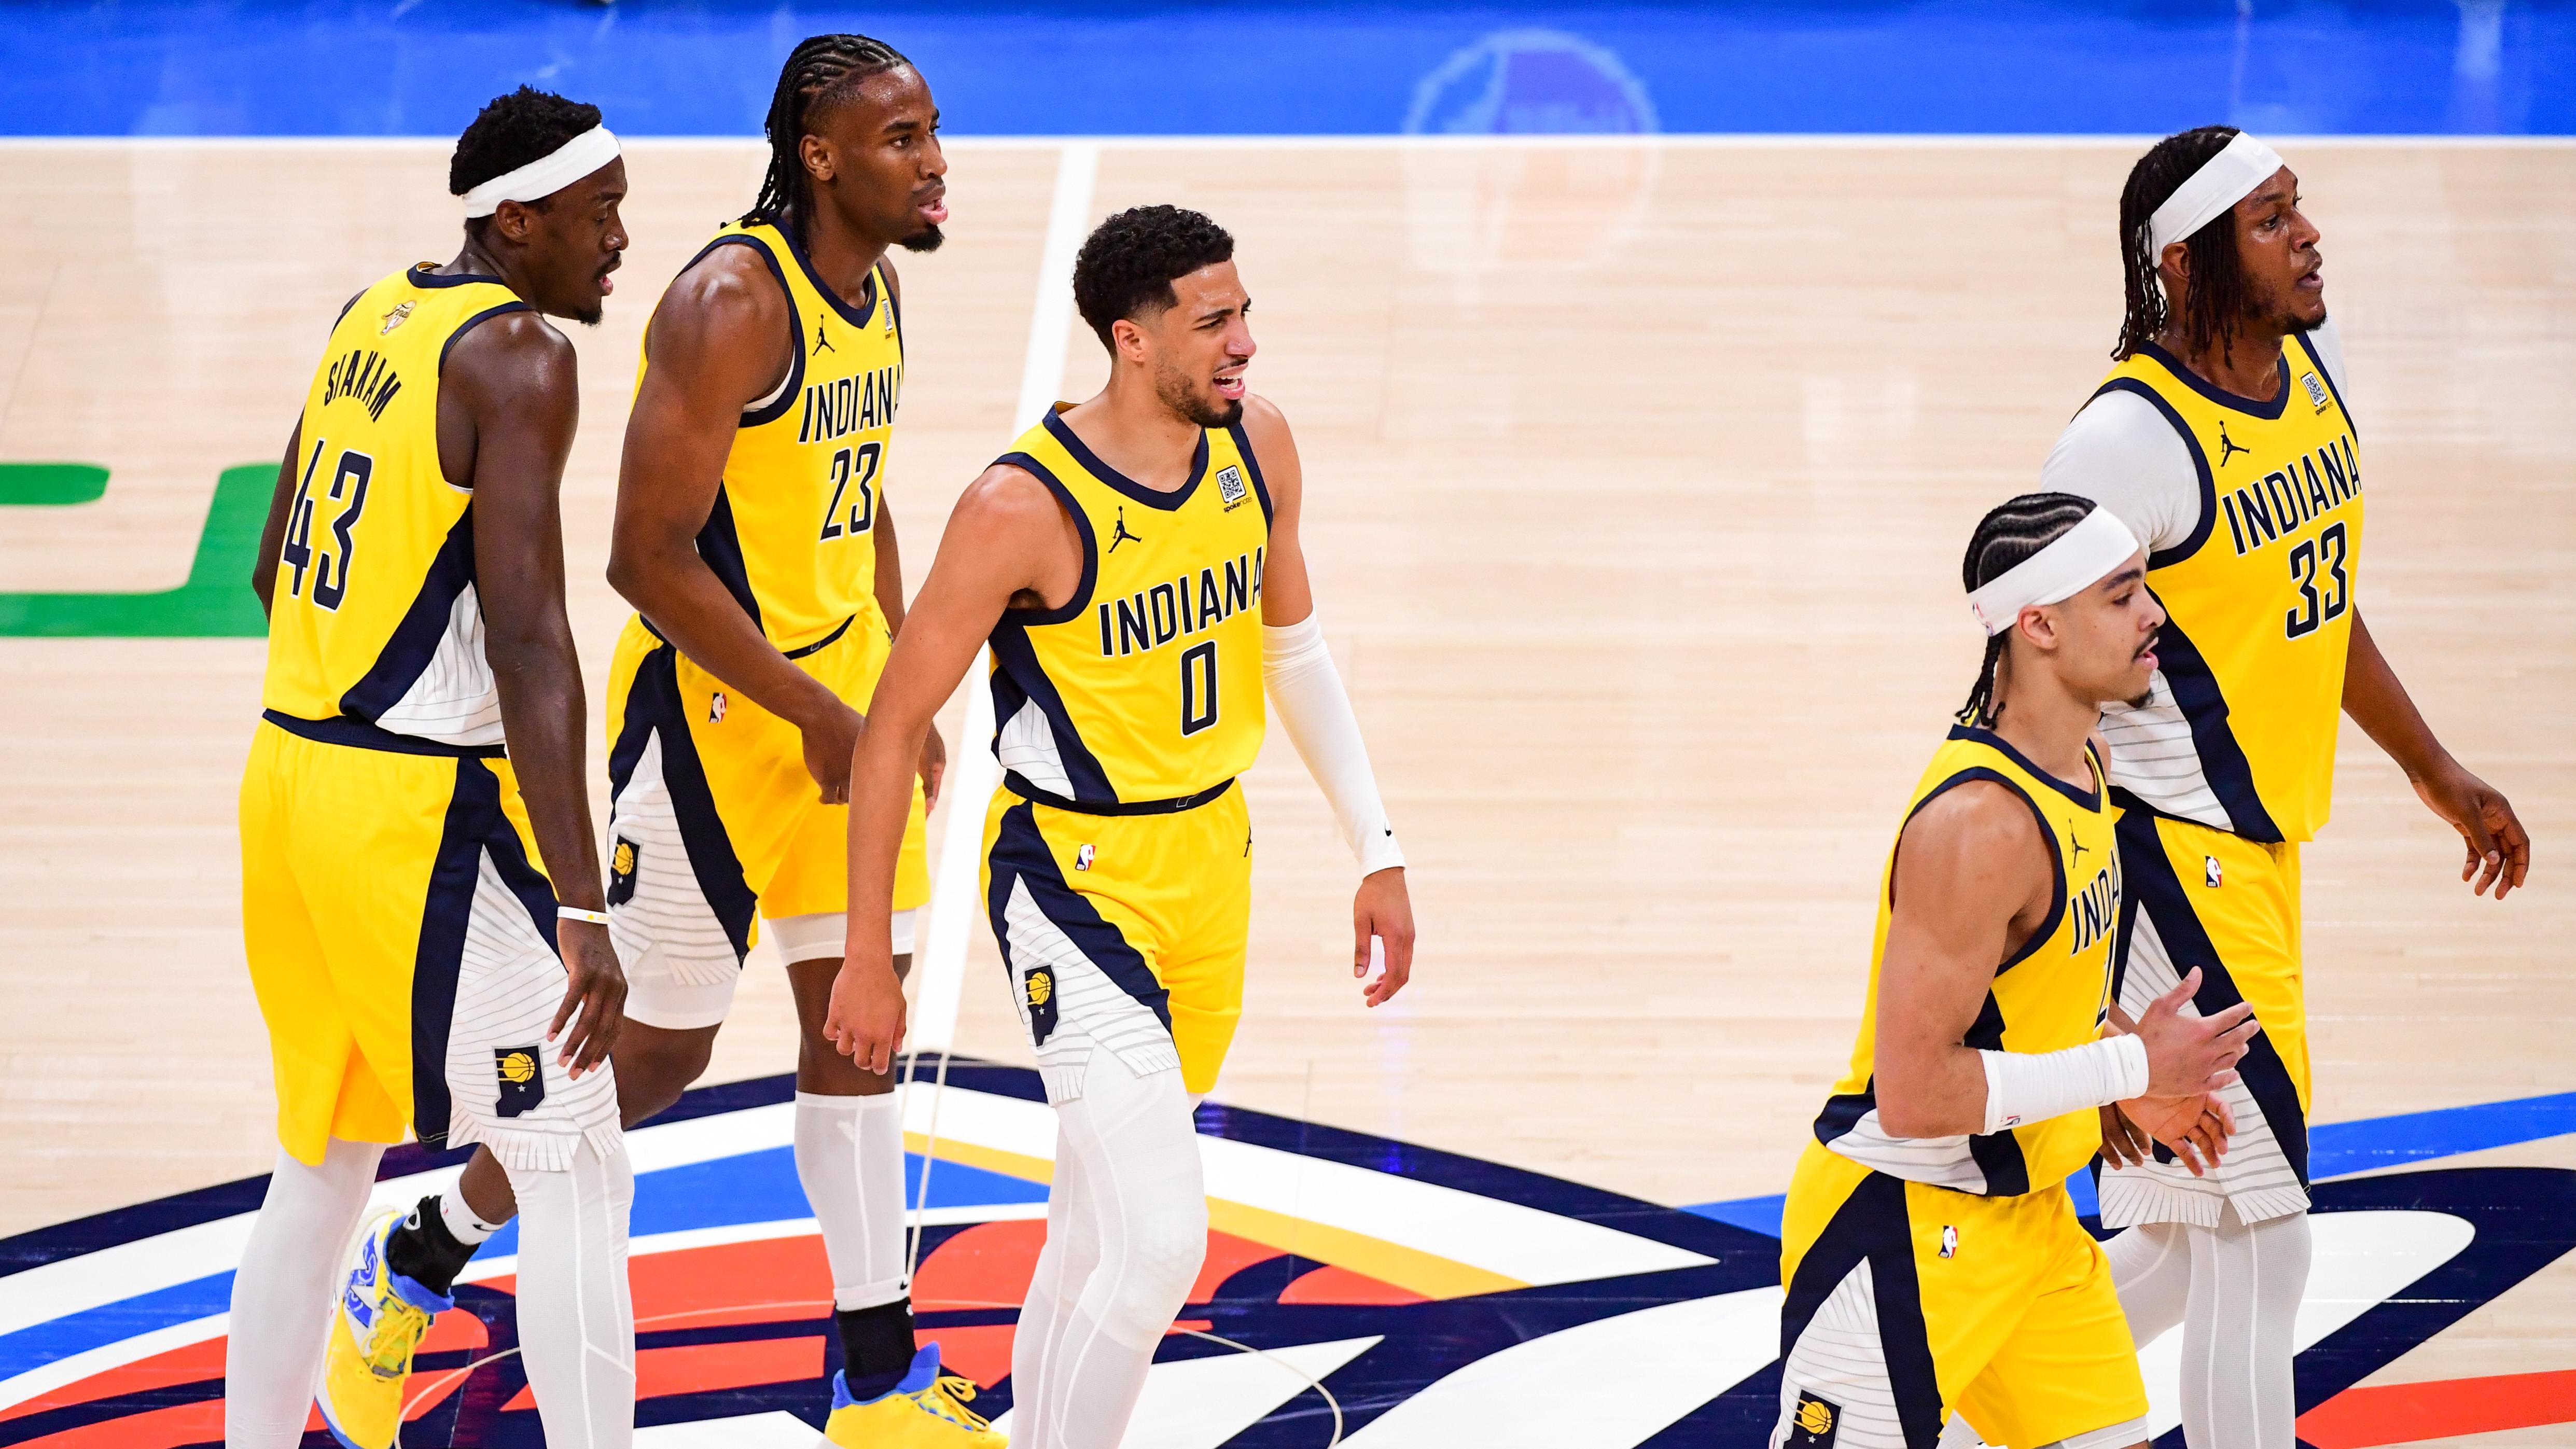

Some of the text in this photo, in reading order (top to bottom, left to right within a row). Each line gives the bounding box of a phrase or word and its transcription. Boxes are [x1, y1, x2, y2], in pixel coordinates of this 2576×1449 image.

[324, 350, 401, 423] SIAKAM
[797, 364, 900, 443] INDIANA
[283, 437, 373, 613] 43
[818, 441, 881, 542] 23
[2220, 433, 2362, 556] INDIANA
[1098, 545, 1264, 657] INDIANA
[2285, 520, 2347, 642] 33
[1180, 638, 1218, 738] 0
